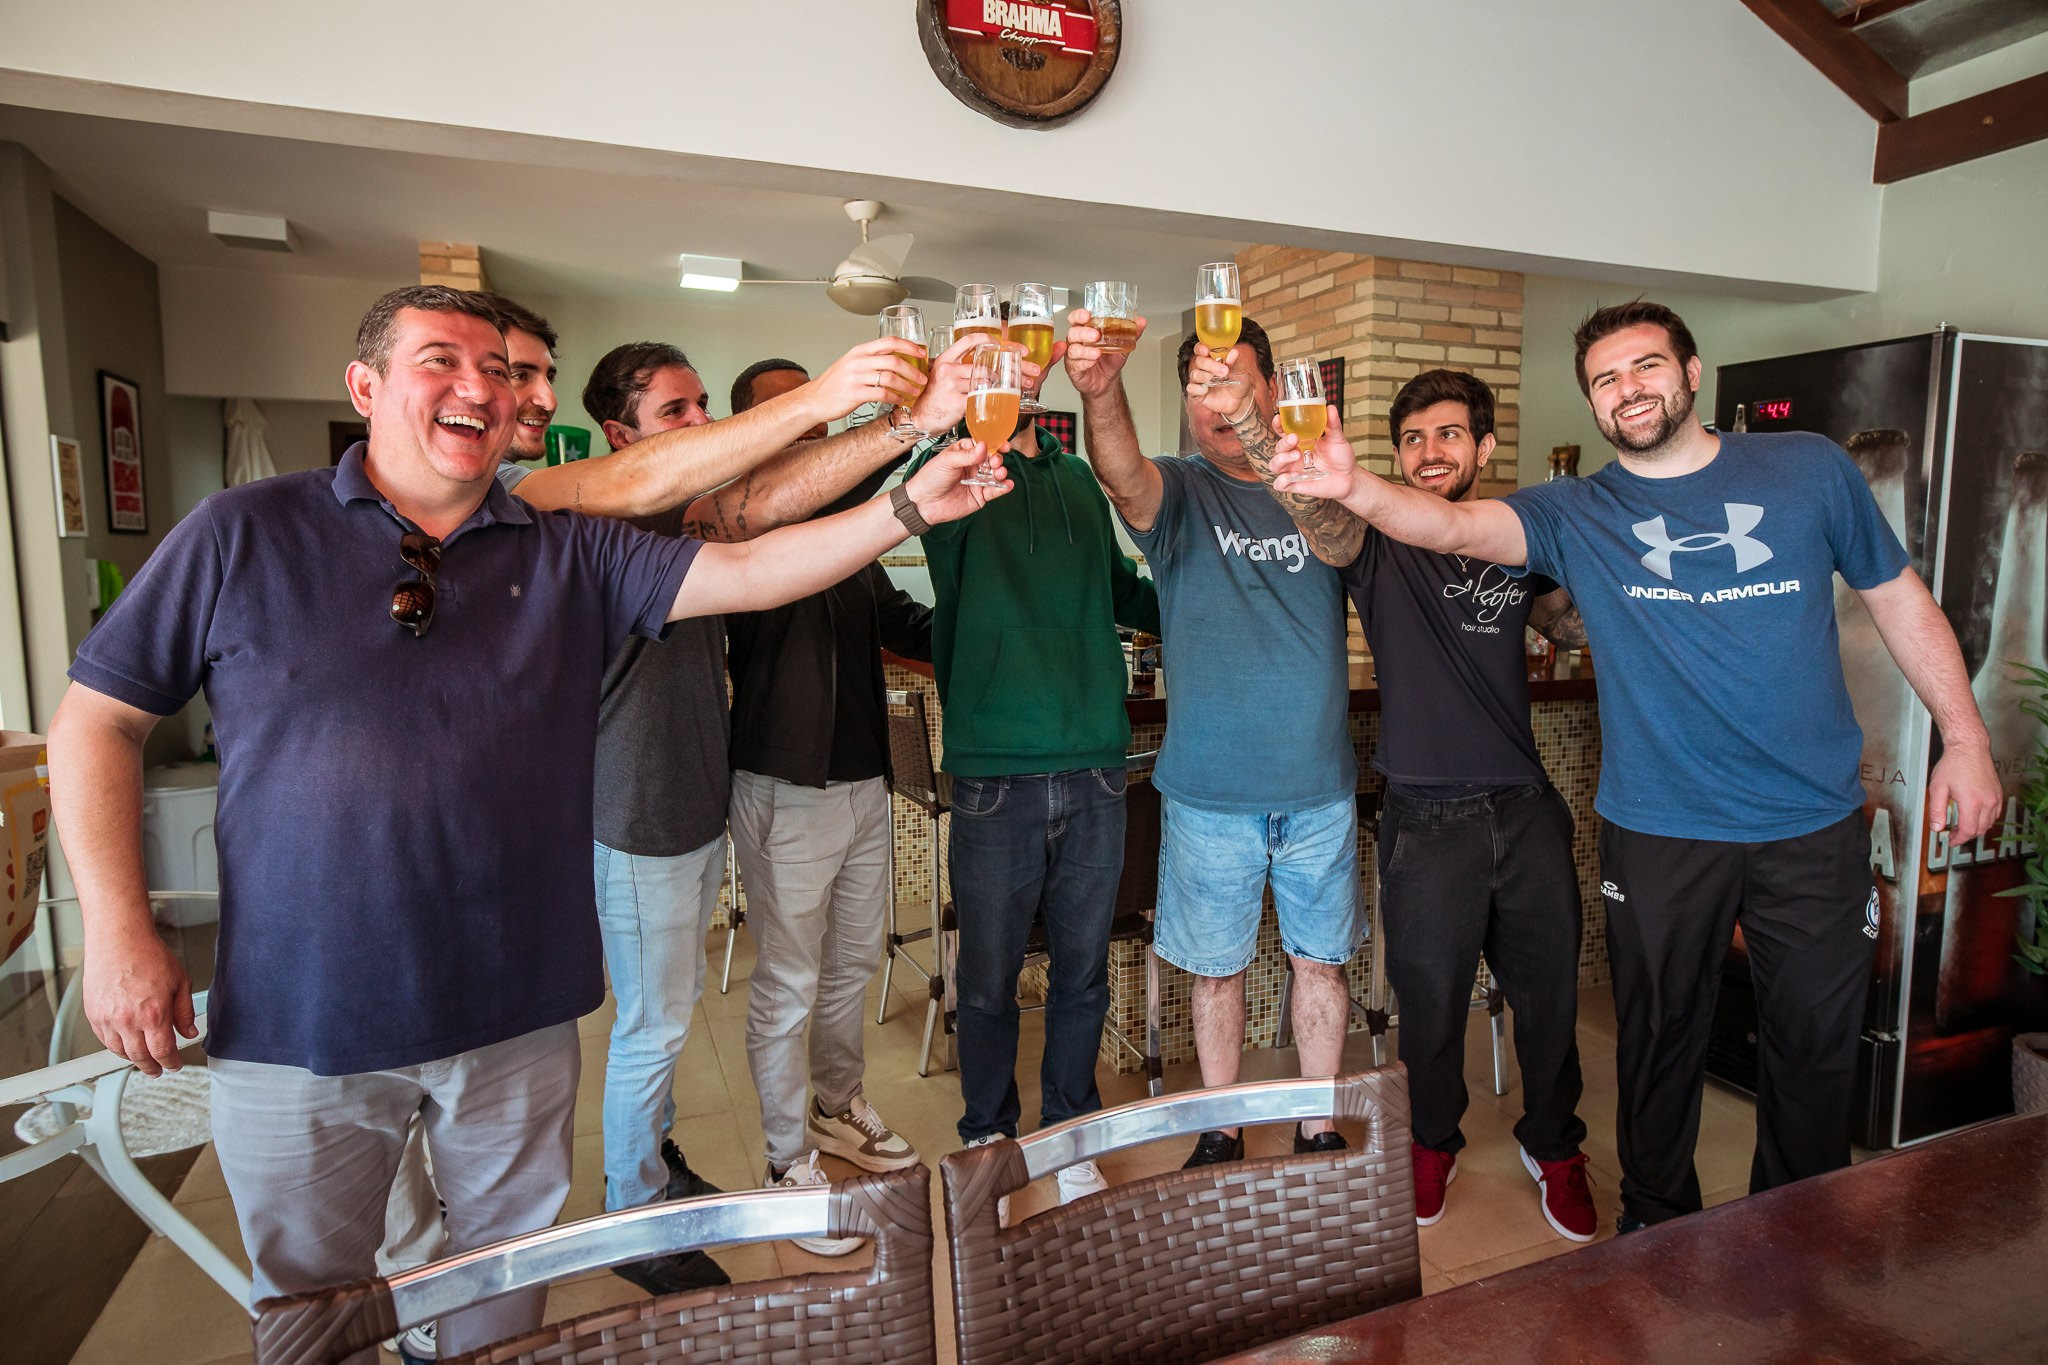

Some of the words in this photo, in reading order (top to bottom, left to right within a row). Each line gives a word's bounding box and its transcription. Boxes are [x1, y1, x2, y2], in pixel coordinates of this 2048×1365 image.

[983, 0, 1063, 37] BRAHMA
[1000, 28, 1040, 45] Chopp
[1214, 525, 1310, 573] Wrangl
[1622, 584, 1695, 603] UNDER
[1700, 579, 1801, 604] ARMOUR
[1461, 621, 1476, 632] hair
[1477, 625, 1500, 634] studio
[1861, 763, 1906, 786] EJA
